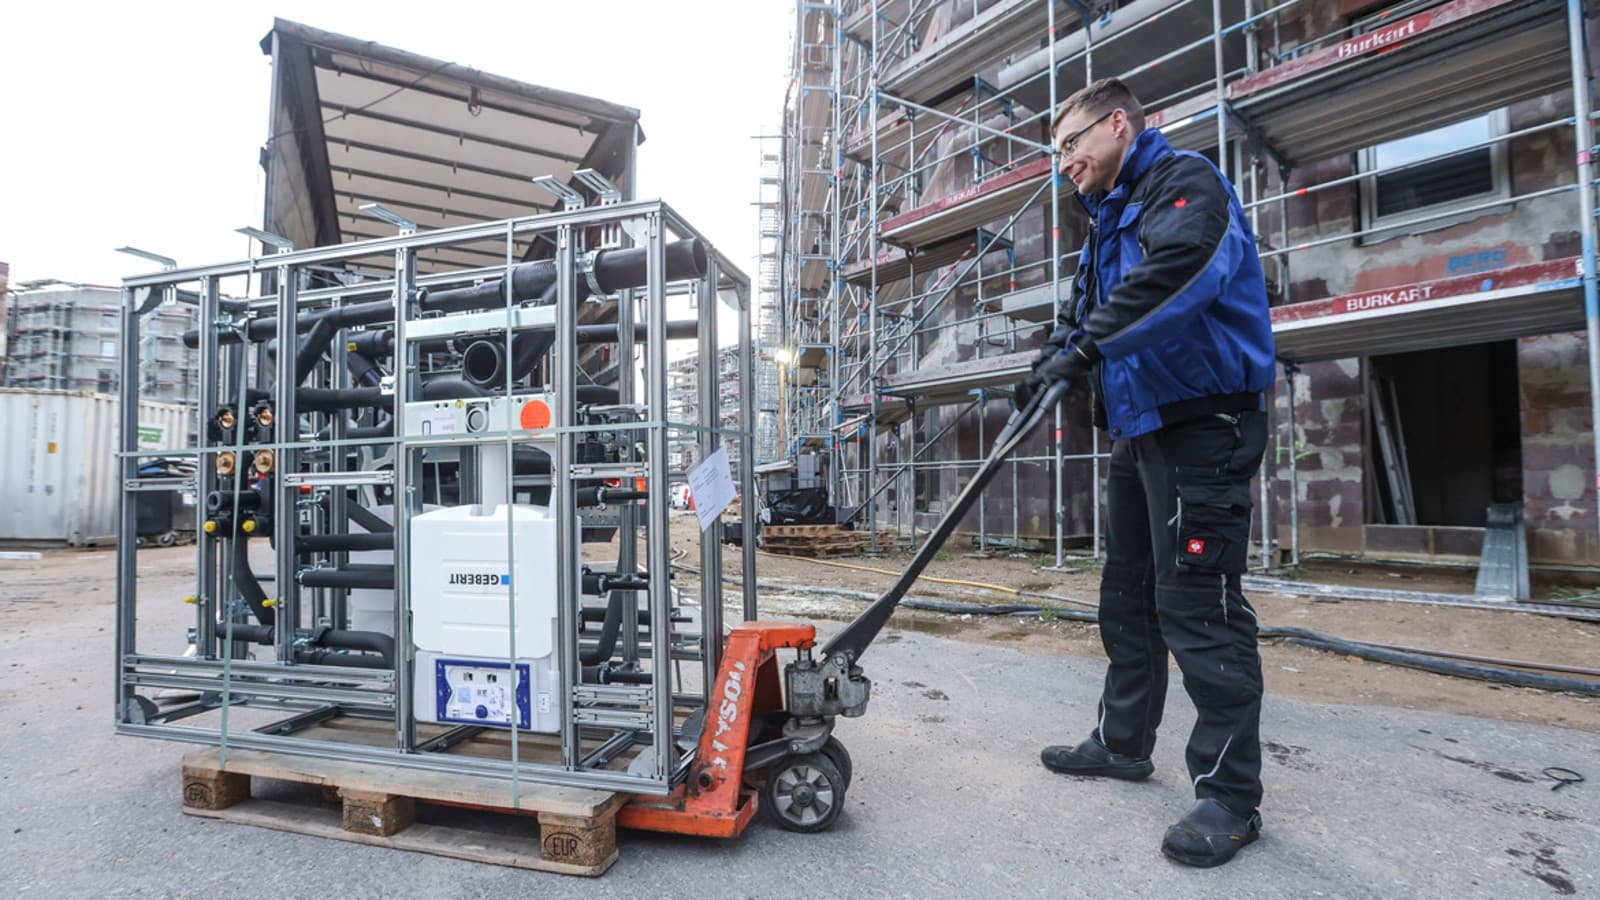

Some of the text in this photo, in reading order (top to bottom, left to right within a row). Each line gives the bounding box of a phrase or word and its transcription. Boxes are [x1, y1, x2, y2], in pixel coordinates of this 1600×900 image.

[1338, 20, 1415, 57] Burkart
[1346, 286, 1434, 311] BURKART
[448, 573, 500, 586] GEBERIT
[552, 836, 579, 858] EUR
